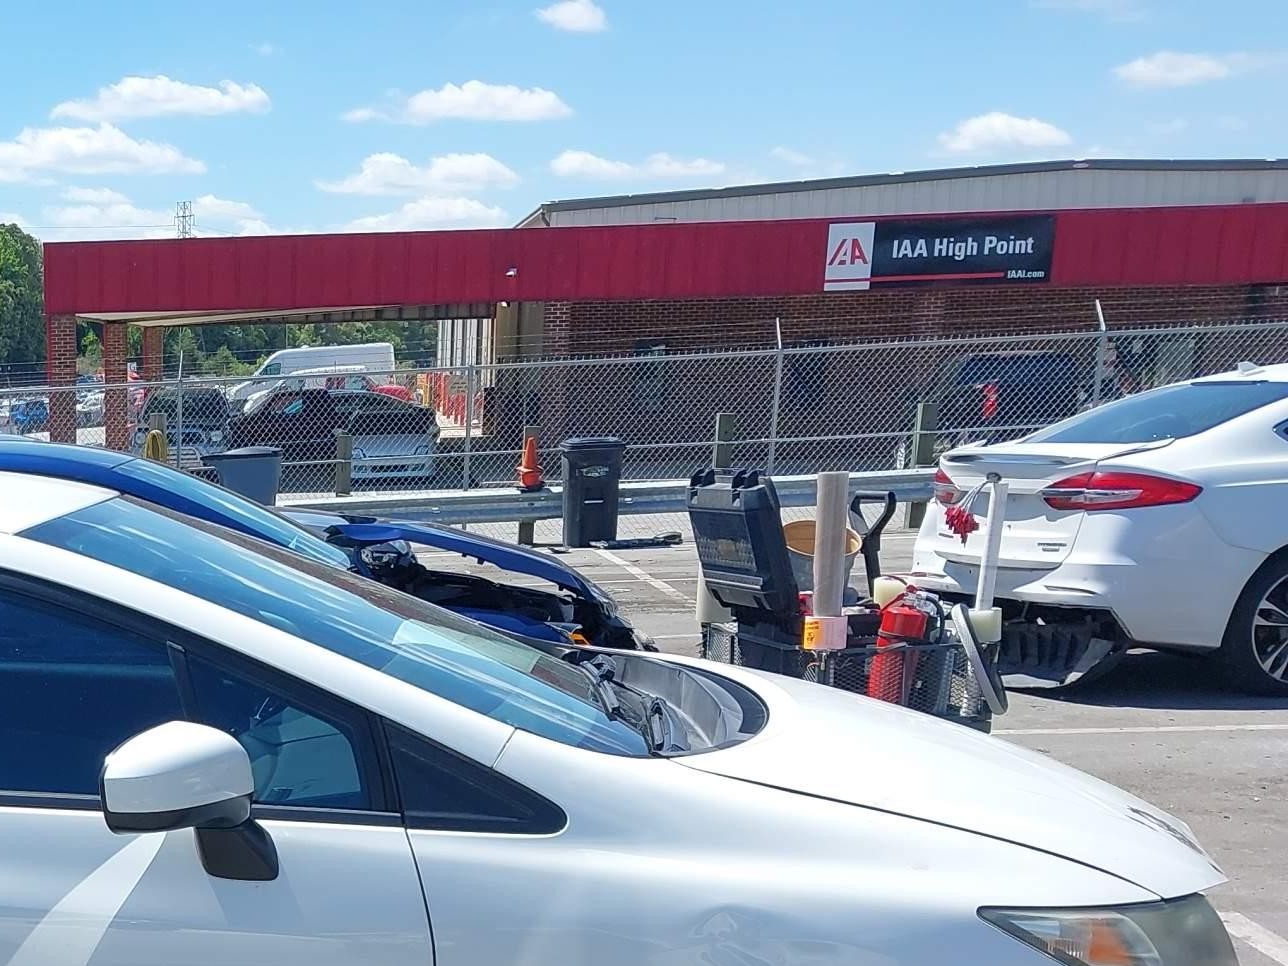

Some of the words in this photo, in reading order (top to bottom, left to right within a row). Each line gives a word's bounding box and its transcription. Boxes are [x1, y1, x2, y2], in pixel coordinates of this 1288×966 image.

[892, 239, 928, 258] IAA
[934, 236, 978, 260] High
[984, 235, 1034, 255] Point
